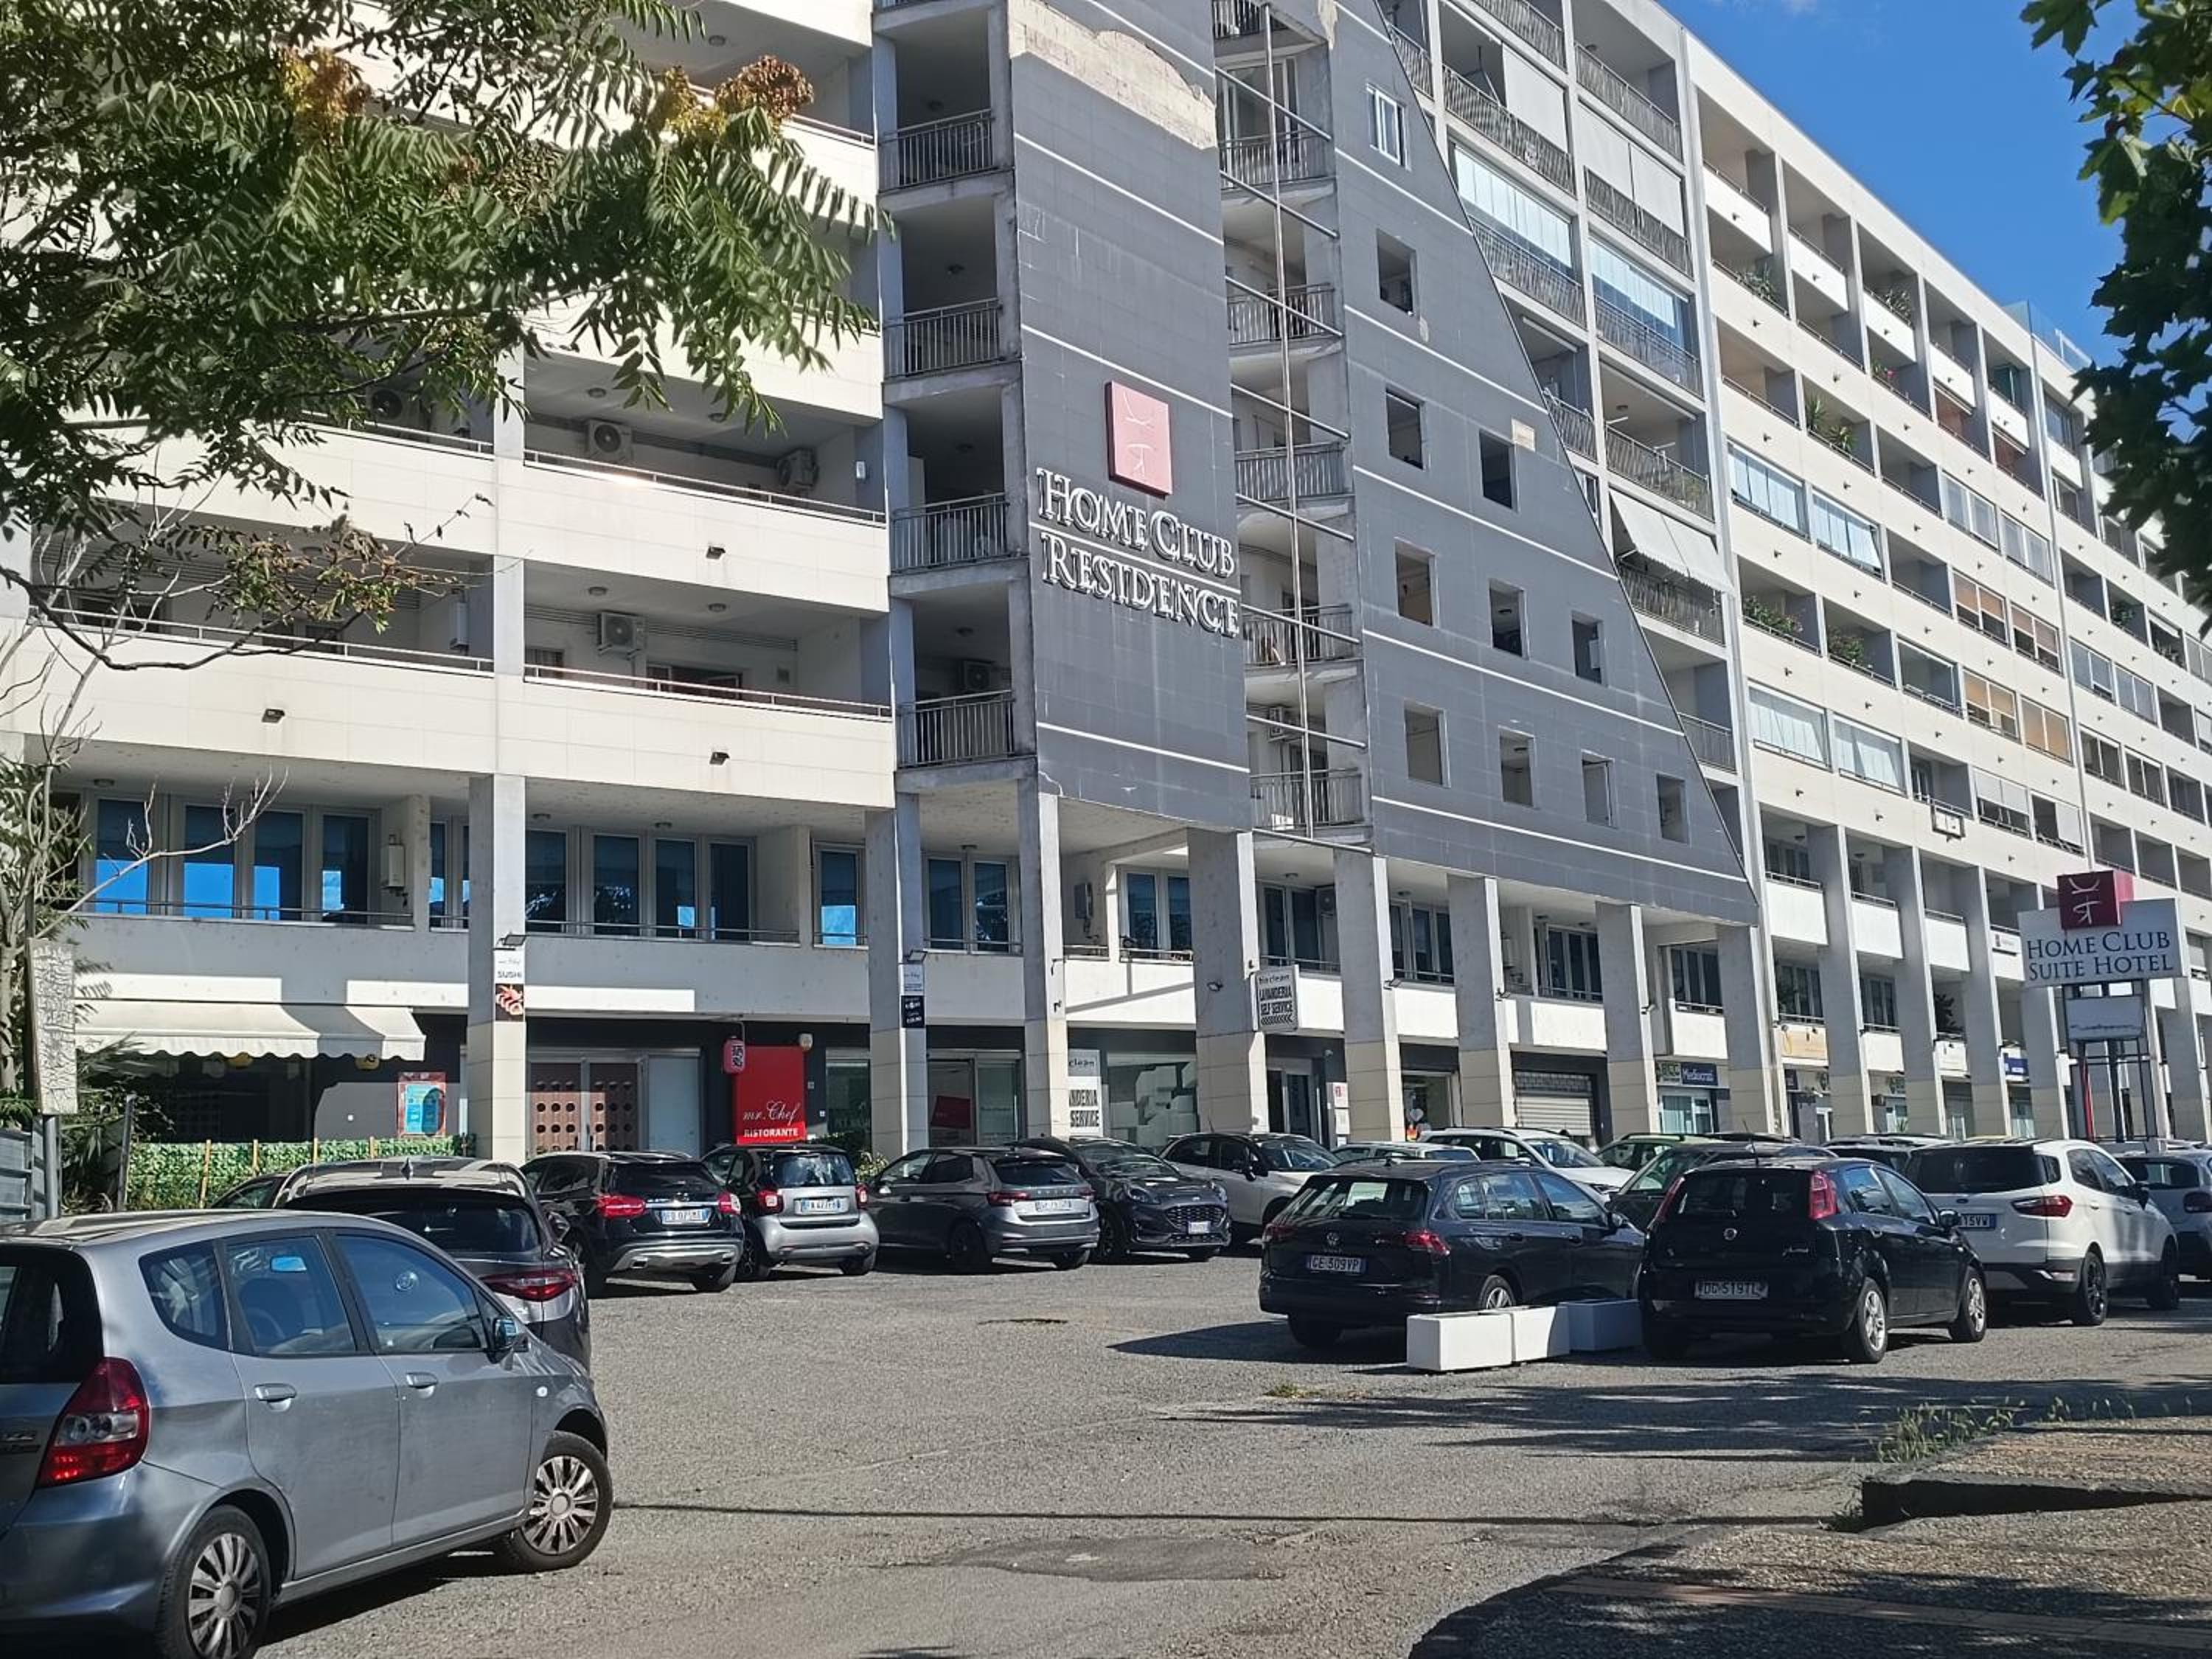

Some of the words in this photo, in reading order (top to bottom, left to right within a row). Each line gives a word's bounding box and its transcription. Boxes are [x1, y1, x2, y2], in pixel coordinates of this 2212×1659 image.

[1036, 467, 1148, 551] HOME
[1150, 510, 1235, 577] CLUB
[1040, 532, 1239, 639] RESIDENCE
[2027, 936, 2096, 959] HOME
[2102, 931, 2171, 952] CLUB
[497, 970, 523, 978] SUSHI
[2029, 961, 2085, 981] SUITE
[2095, 954, 2174, 975] HOTEL
[1272, 1001, 1293, 1014] SERVICE
[767, 1099, 801, 1126] Chef
[1070, 1110, 1099, 1127] SERVICE
[743, 1127, 799, 1138] RISTORANTE
